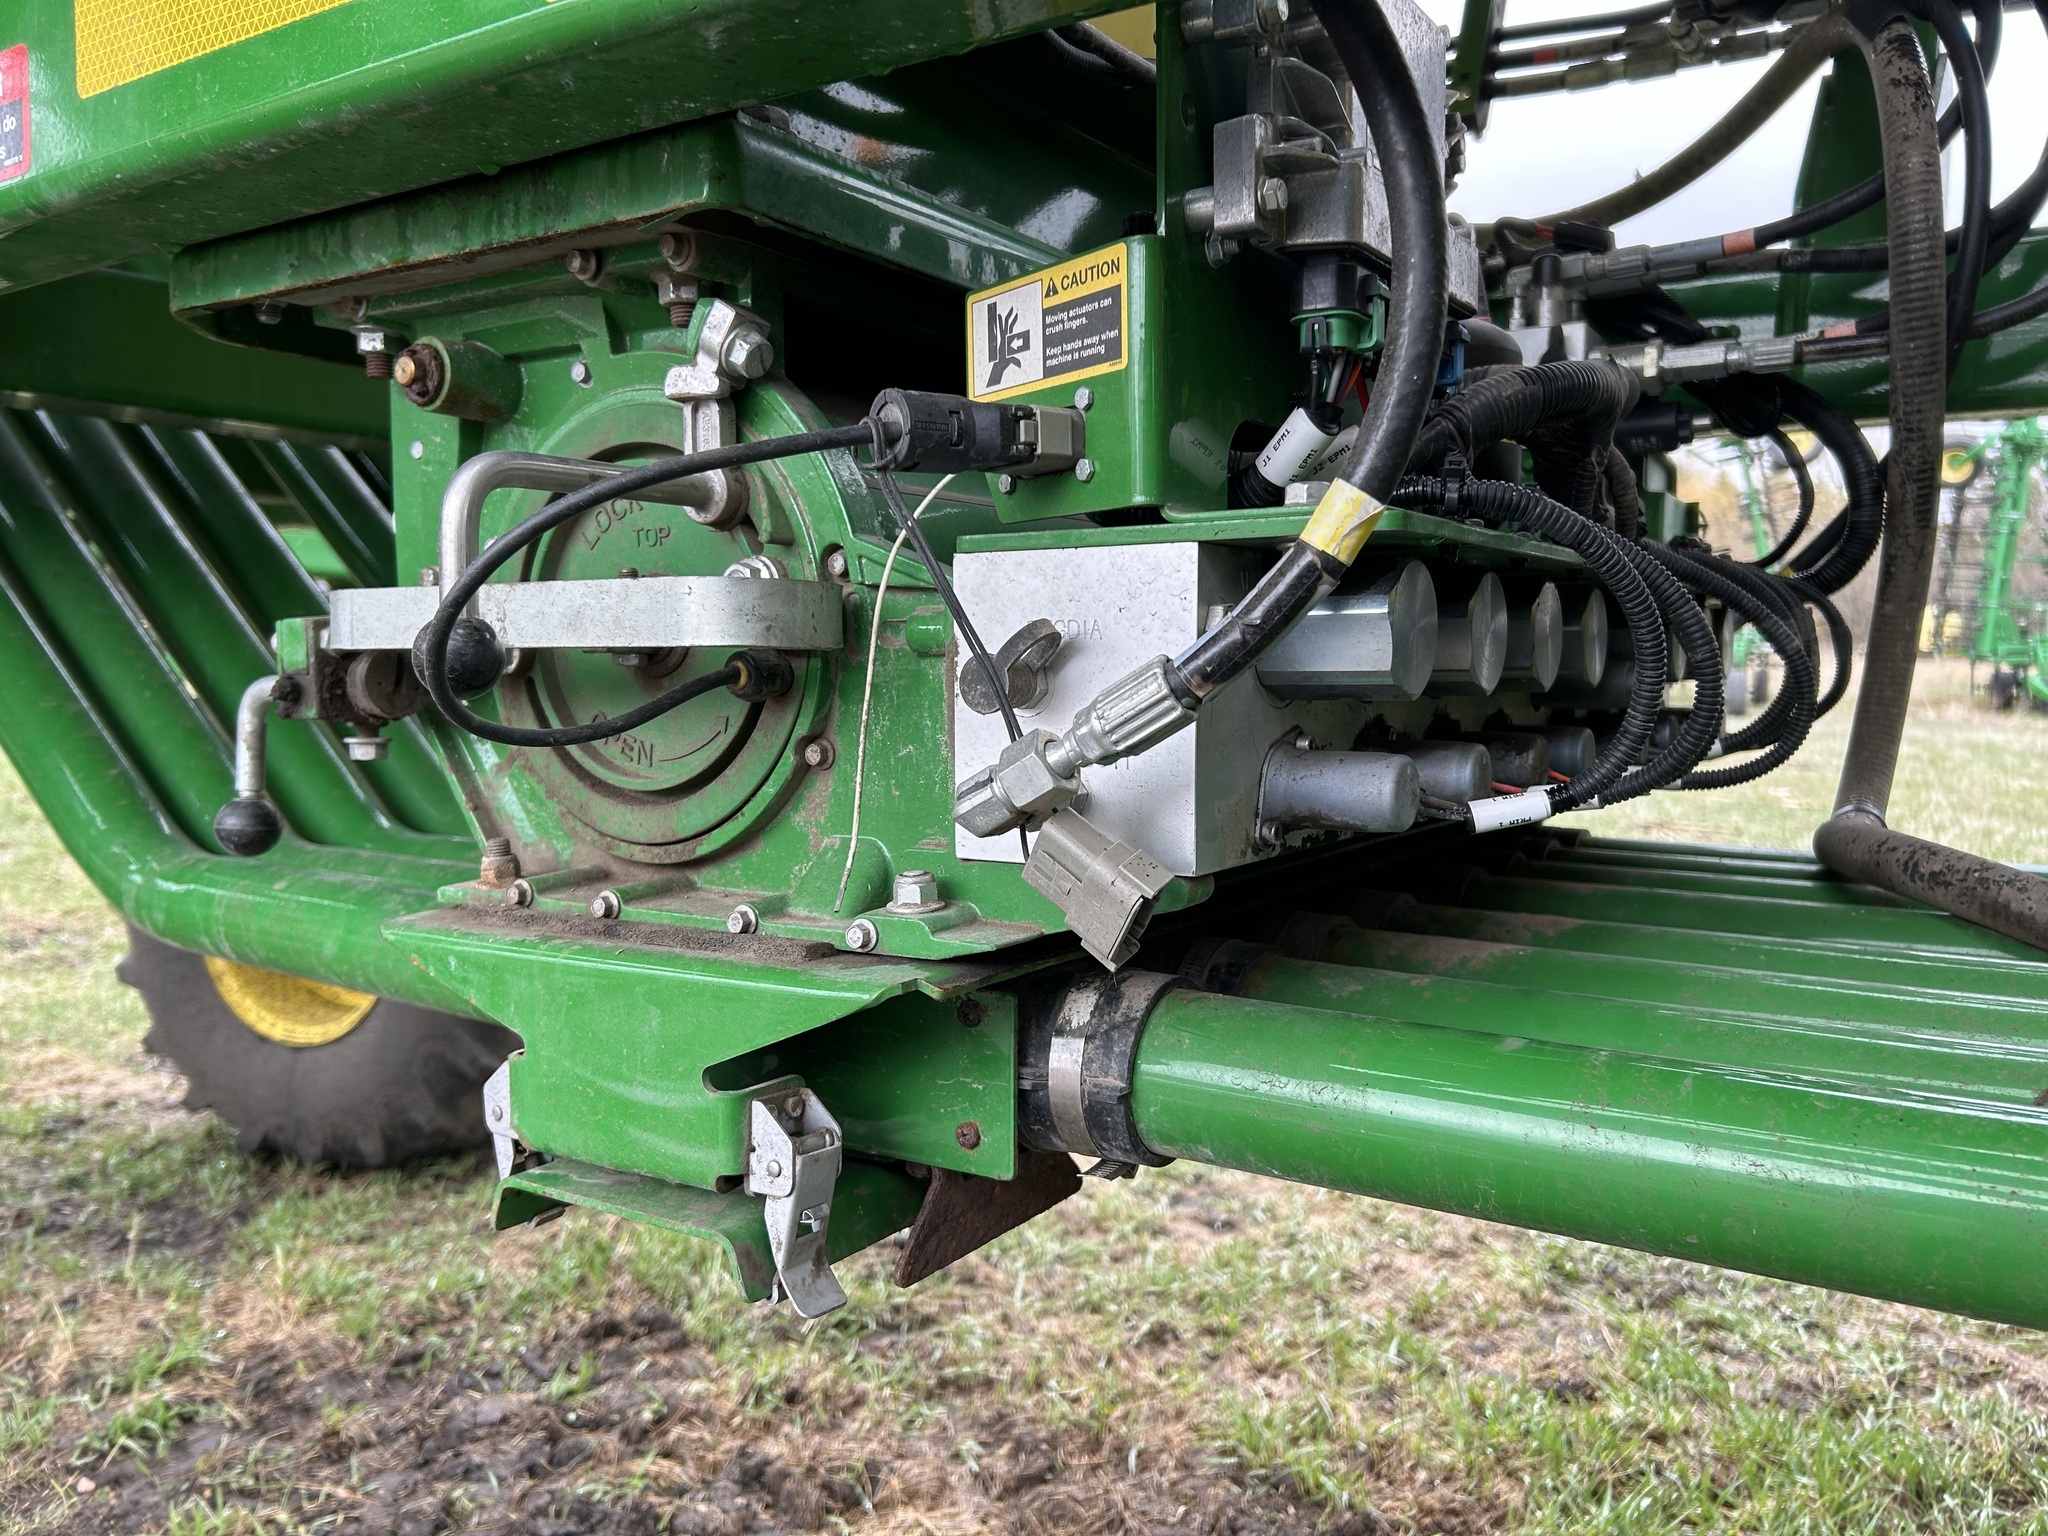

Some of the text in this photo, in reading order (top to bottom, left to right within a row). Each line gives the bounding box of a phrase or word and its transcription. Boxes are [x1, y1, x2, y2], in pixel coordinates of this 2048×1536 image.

[1061, 257, 1120, 291] CAUTION
[1045, 297, 1112, 325] Moving actuators can
[1045, 316, 1088, 335] crush fingers.
[1046, 329, 1119, 356] Keep hands away when
[1046, 344, 1105, 367] machine is running
[1262, 428, 1291, 467] J1 EPM1
[1298, 449, 1318, 469] EPM1
[1313, 444, 1351, 475] J2 EPM1
[633, 525, 671, 548] TOP
